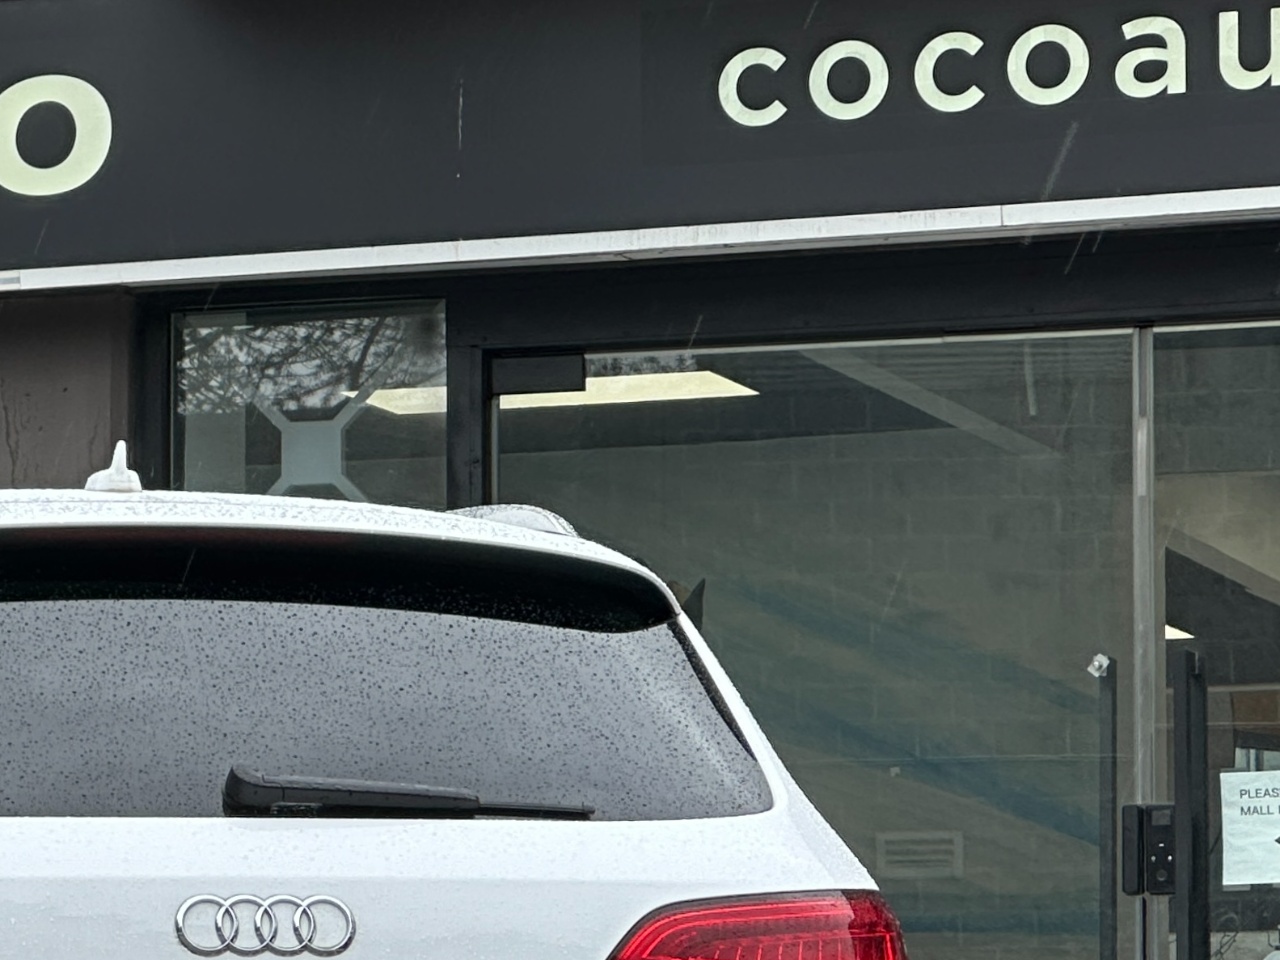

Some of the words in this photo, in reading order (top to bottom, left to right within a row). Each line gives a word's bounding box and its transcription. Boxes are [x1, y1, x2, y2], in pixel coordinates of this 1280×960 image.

[718, 7, 1280, 127] cocoau
[1239, 787, 1280, 799] PLEAS
[1240, 805, 1275, 816] MALL
